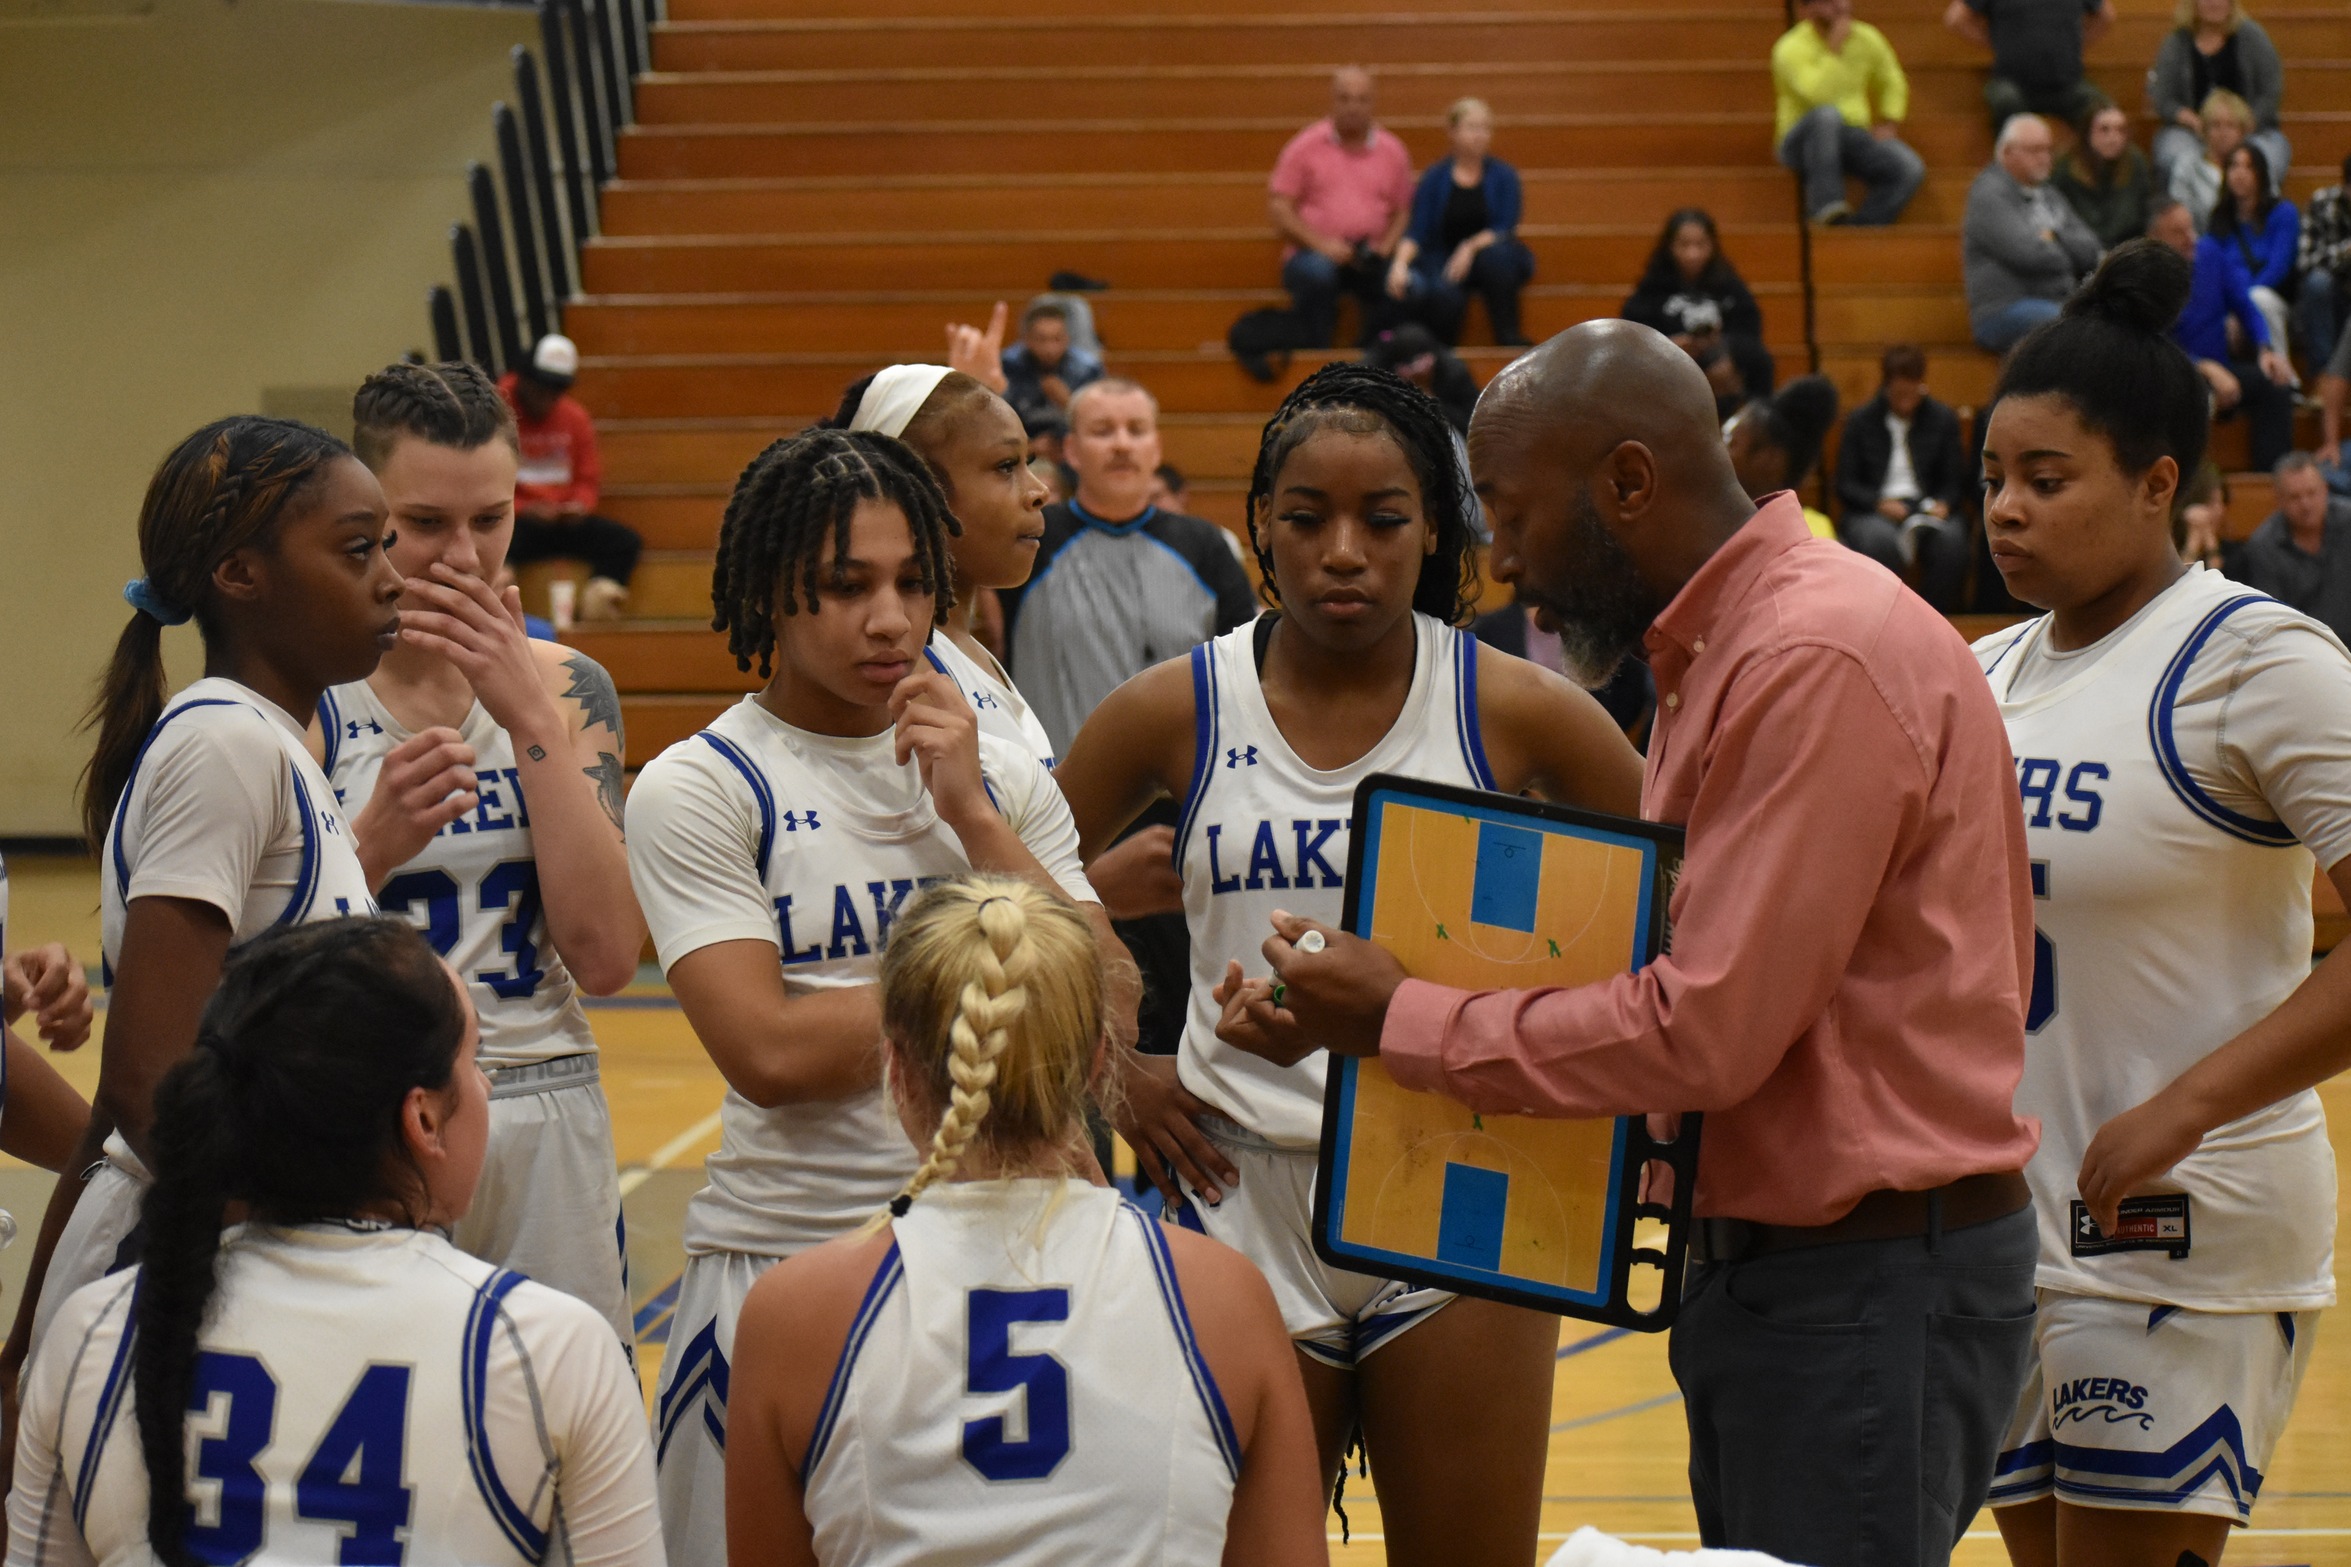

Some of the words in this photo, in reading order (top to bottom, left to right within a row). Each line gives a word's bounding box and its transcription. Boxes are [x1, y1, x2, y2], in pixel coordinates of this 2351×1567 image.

[1206, 818, 1352, 896] LAK
[957, 1285, 1076, 1486] 5
[2053, 1378, 2148, 1415] LAKERS
[183, 1346, 418, 1566] 34
